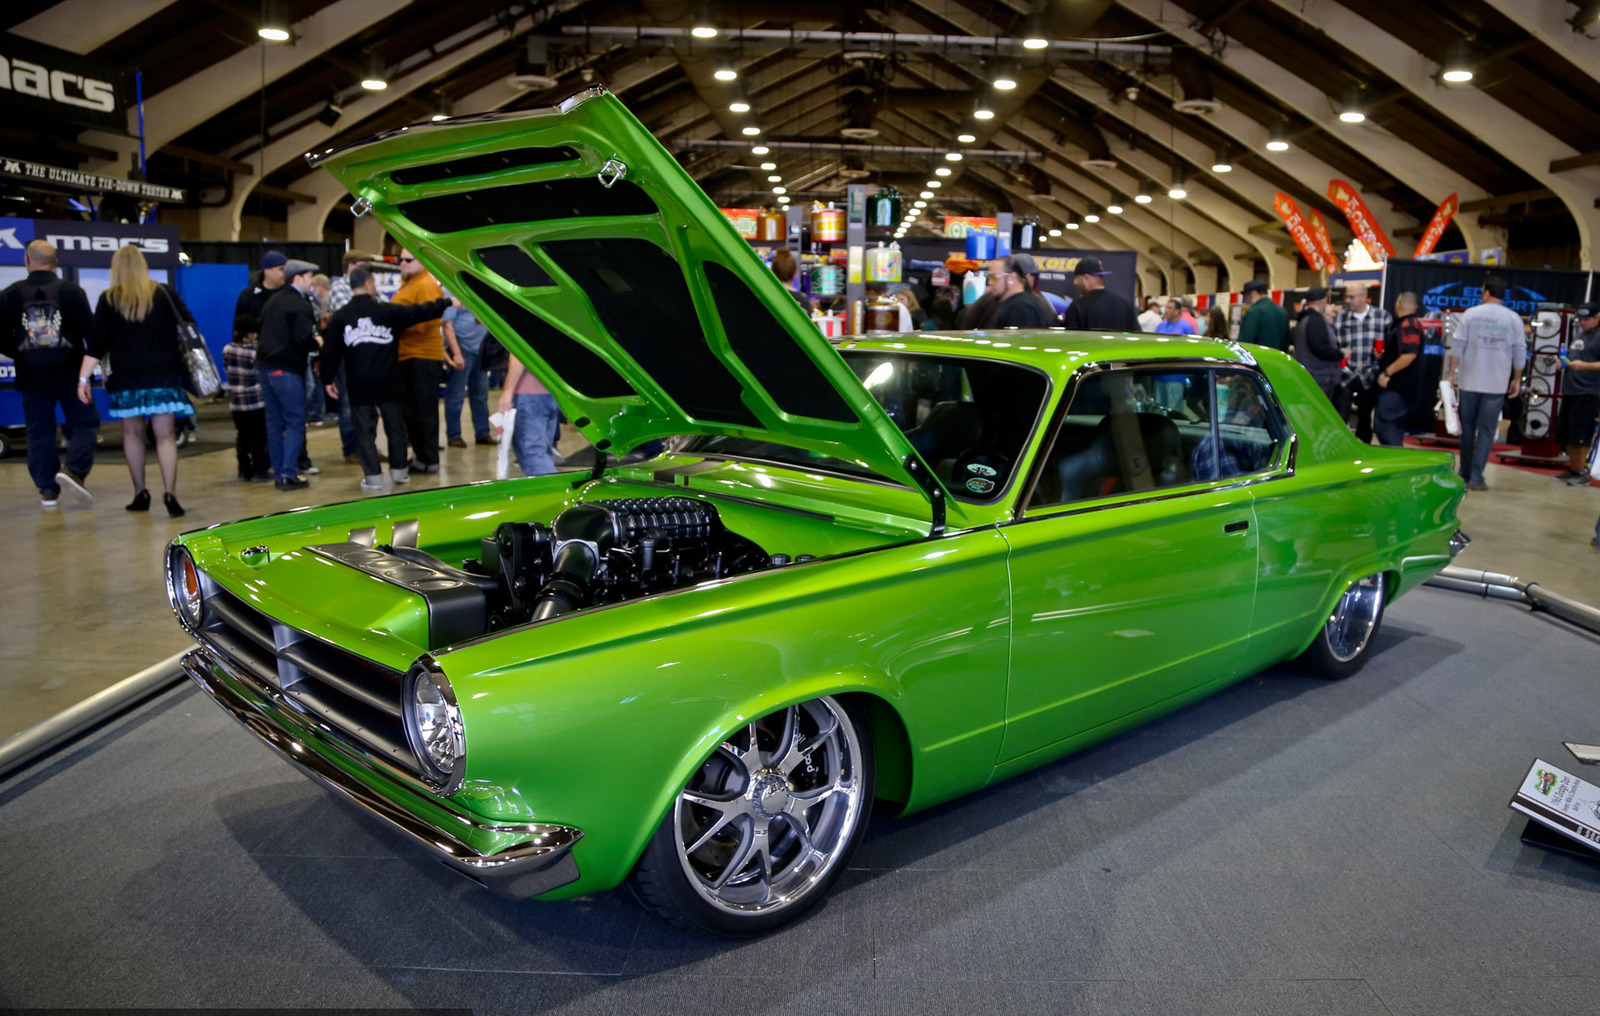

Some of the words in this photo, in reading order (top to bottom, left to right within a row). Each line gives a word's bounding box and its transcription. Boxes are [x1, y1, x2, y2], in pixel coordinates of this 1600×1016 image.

[0, 54, 115, 113] ac's
[25, 163, 46, 178] THE
[49, 168, 97, 187] ULTIMATE
[98, 177, 140, 194] TIE-DOWN
[141, 184, 170, 198] TESTER
[46, 235, 169, 253] mac's
[1032, 256, 1082, 272] KOLO
[1463, 286, 1512, 300] EDE
